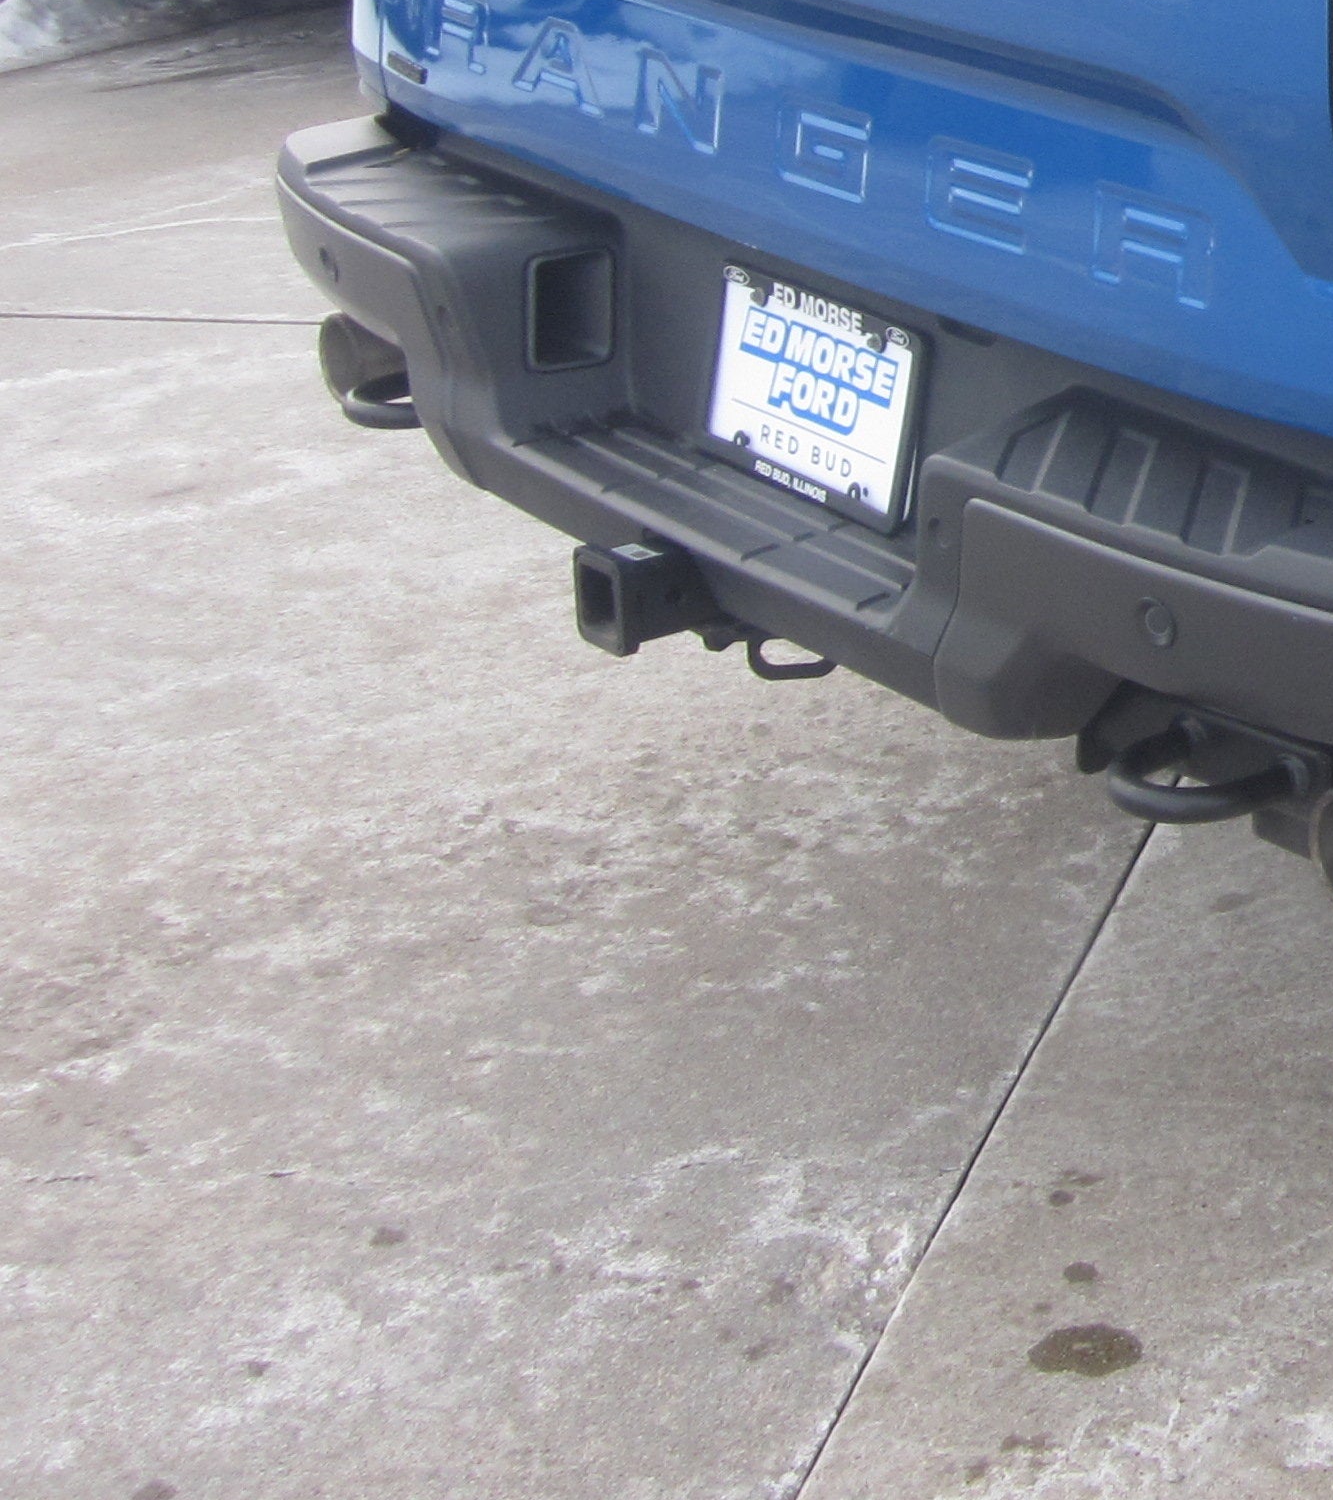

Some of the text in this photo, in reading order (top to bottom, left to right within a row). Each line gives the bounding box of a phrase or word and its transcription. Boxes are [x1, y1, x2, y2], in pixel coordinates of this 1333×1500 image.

[773, 282, 863, 336] ED MORSE
[739, 308, 899, 410] ED MORSE
[767, 360, 860, 436] FORD
[754, 459, 772, 477] RED
[760, 423, 852, 478] RED BUD
